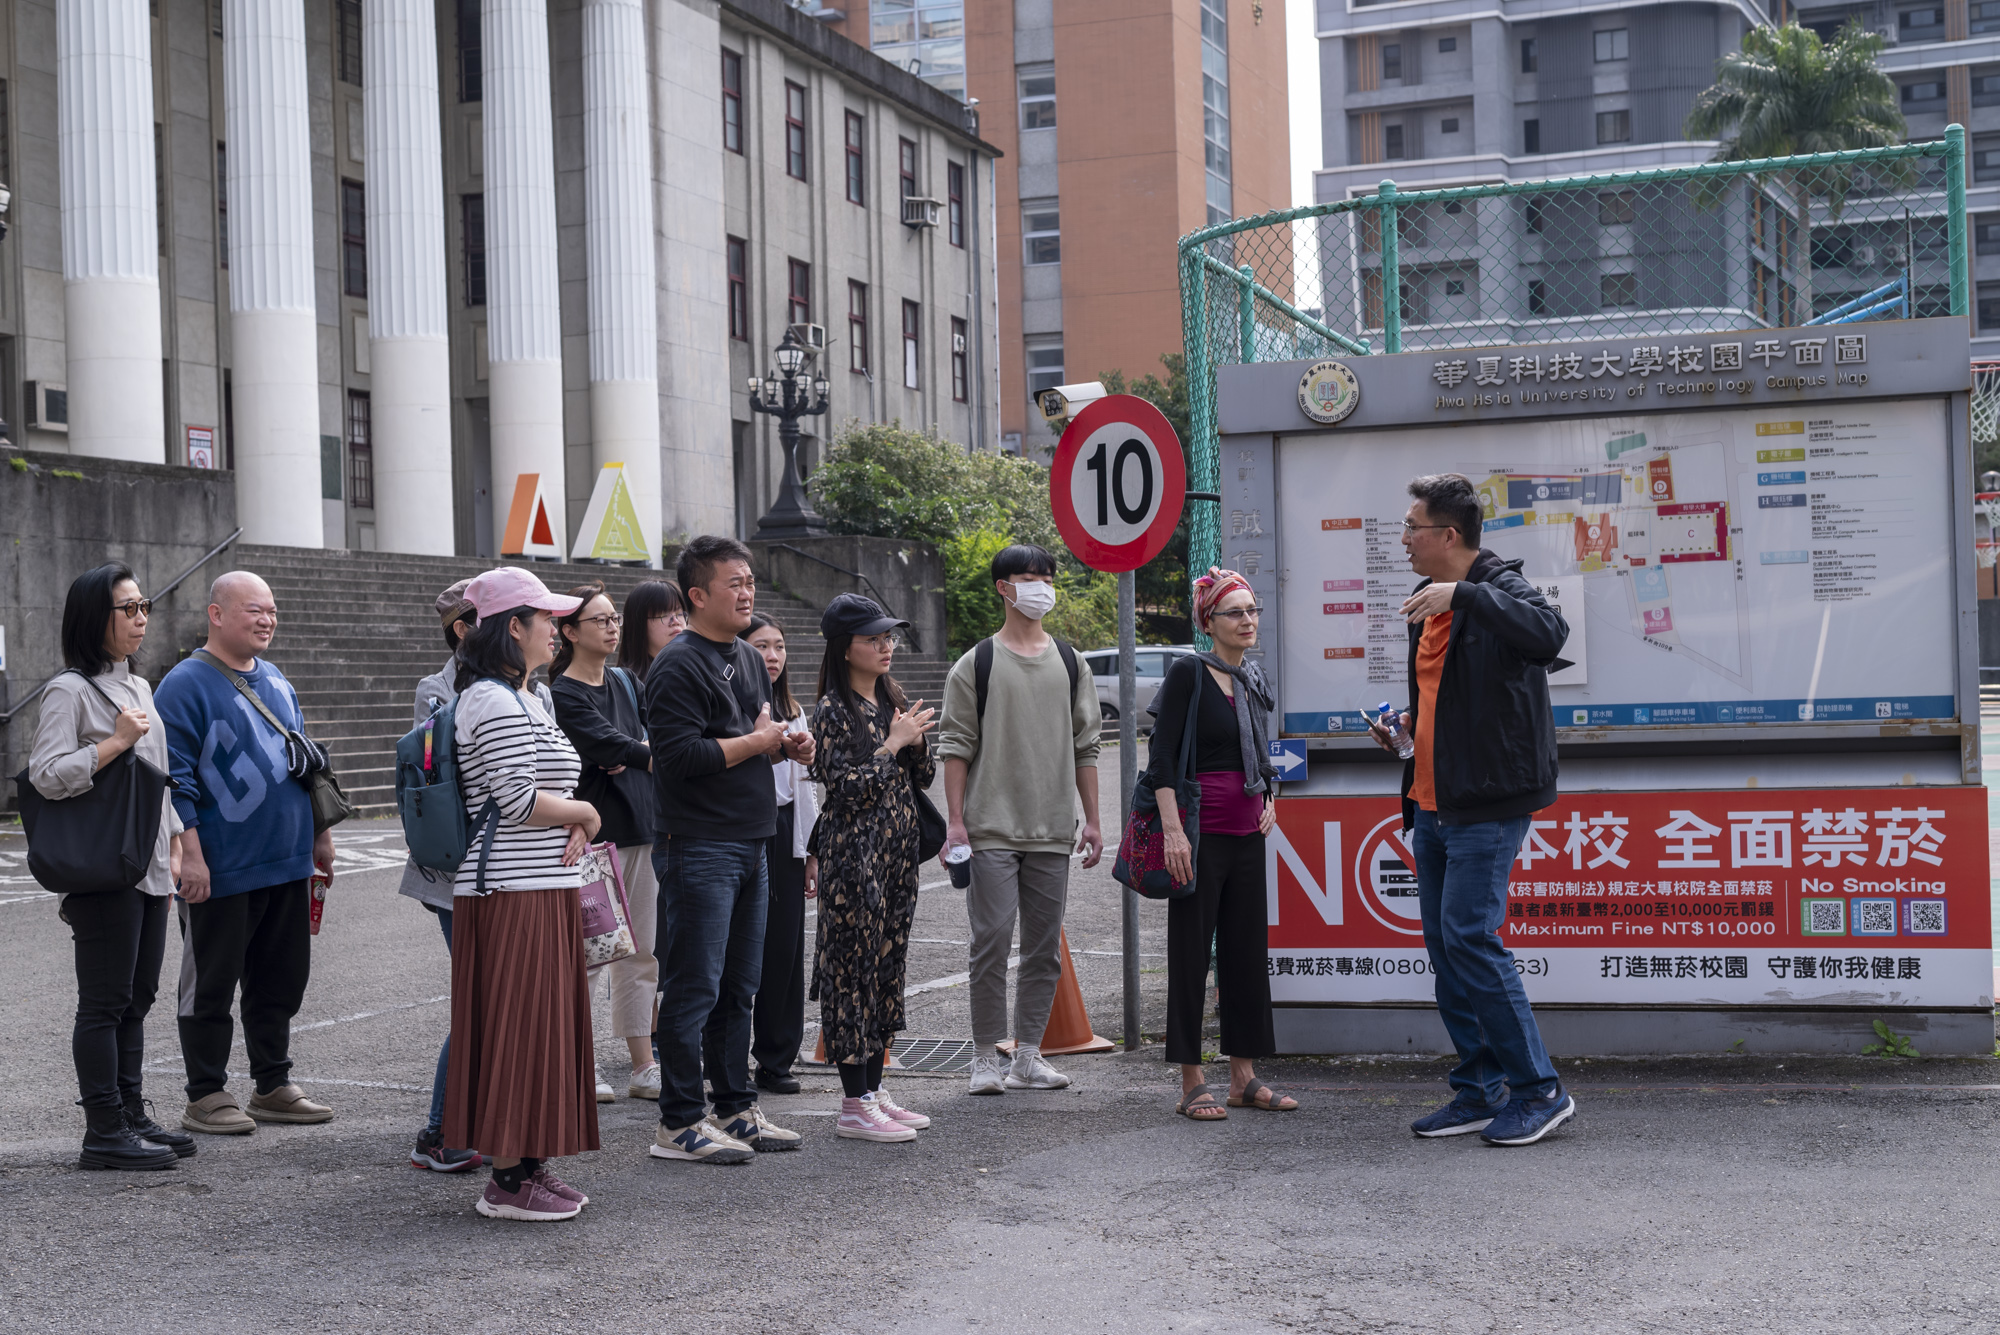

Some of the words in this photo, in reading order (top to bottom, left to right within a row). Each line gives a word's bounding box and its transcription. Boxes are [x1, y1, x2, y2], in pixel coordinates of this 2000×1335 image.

[1433, 334, 1867, 388] 華夏科技大學校園平面圖
[1435, 395, 1465, 409] Hwa
[1473, 392, 1511, 407] Hsia
[1520, 386, 1616, 403] University
[1627, 383, 1646, 397] of
[1657, 378, 1755, 395] Technology
[1766, 374, 1827, 391] Campus
[1837, 371, 1868, 386] Map
[1087, 438, 1153, 526] 10
[1688, 529, 1695, 537] C
[1655, 610, 1661, 618] B
[1653, 708, 1696, 717] 腳踏車停車場
[1736, 706, 1764, 715] 便利商店
[1515, 811, 1629, 870] 本校
[1655, 807, 1947, 868] 全面禁菸
[1507, 880, 1773, 897] 《菸害防制法》規定大專校院全面禁菸
[1801, 878, 1834, 893] No
[1843, 877, 1946, 895] Smoking
[1509, 901, 1774, 918] 違者處新臺幣2,000至10,000元罰鍰
[1509, 921, 1604, 936] Maximum
[1612, 921, 1654, 935] Fine
[1662, 921, 1776, 937] NT$10,000
[1600, 955, 1748, 978] 打造無菸校園
[1767, 956, 1922, 980] 守護你我健康
